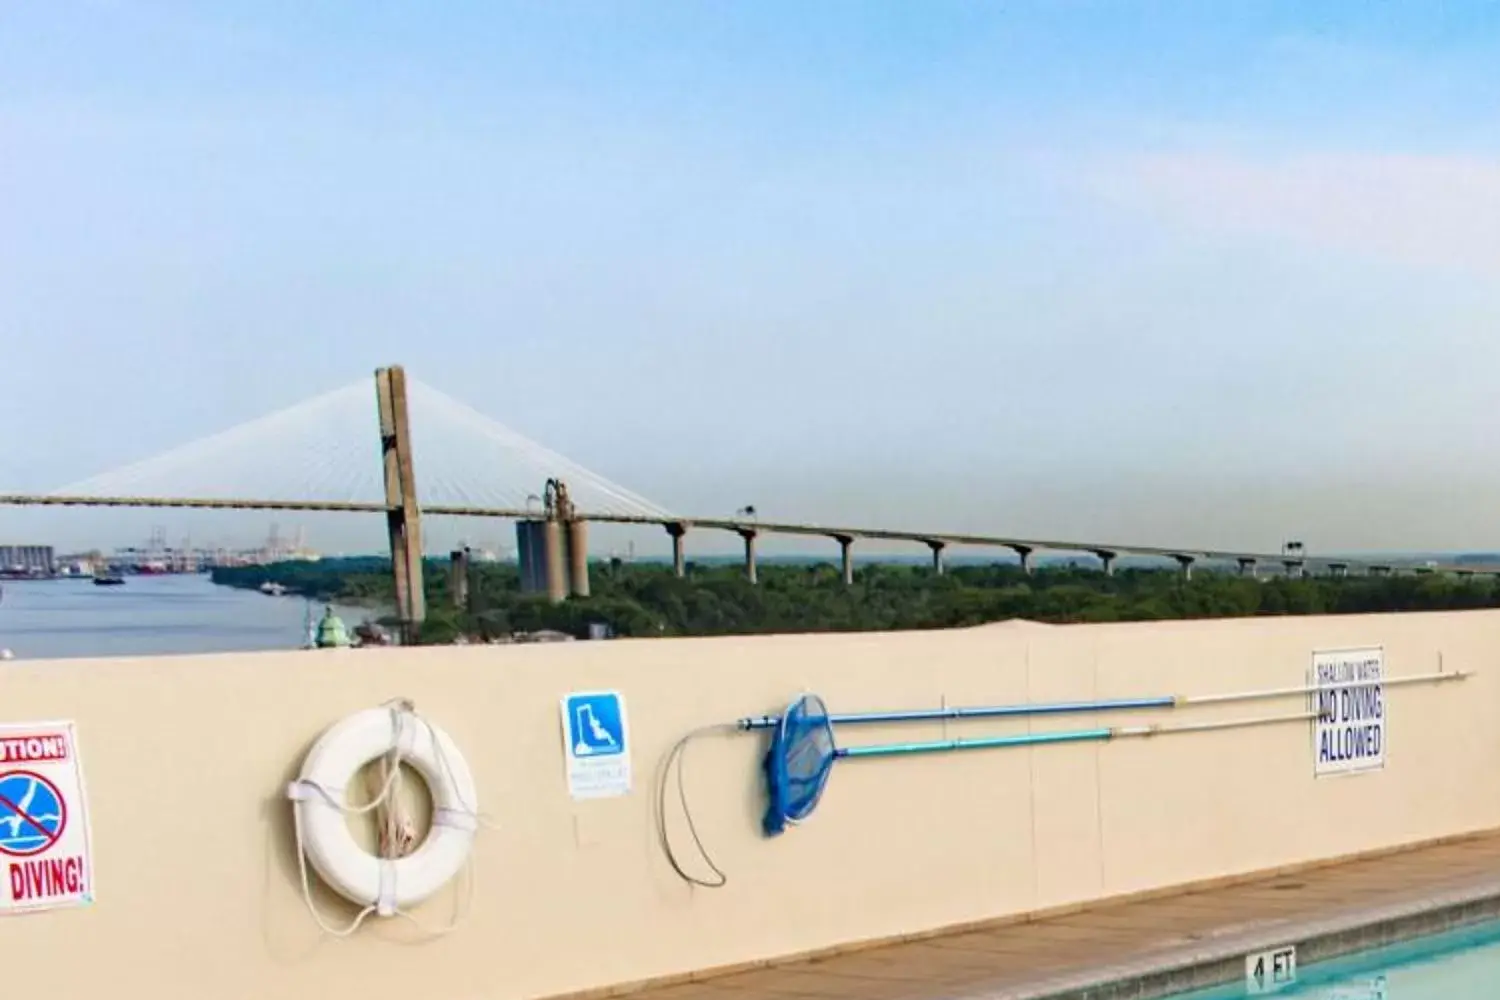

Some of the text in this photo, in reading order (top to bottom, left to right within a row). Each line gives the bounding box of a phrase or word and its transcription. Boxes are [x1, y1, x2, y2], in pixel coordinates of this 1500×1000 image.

[1320, 685, 1381, 724] NO DIVING
[1319, 724, 1381, 762] ALLOWED
[9, 856, 84, 900] DIVING!
[1273, 950, 1293, 983] FT
